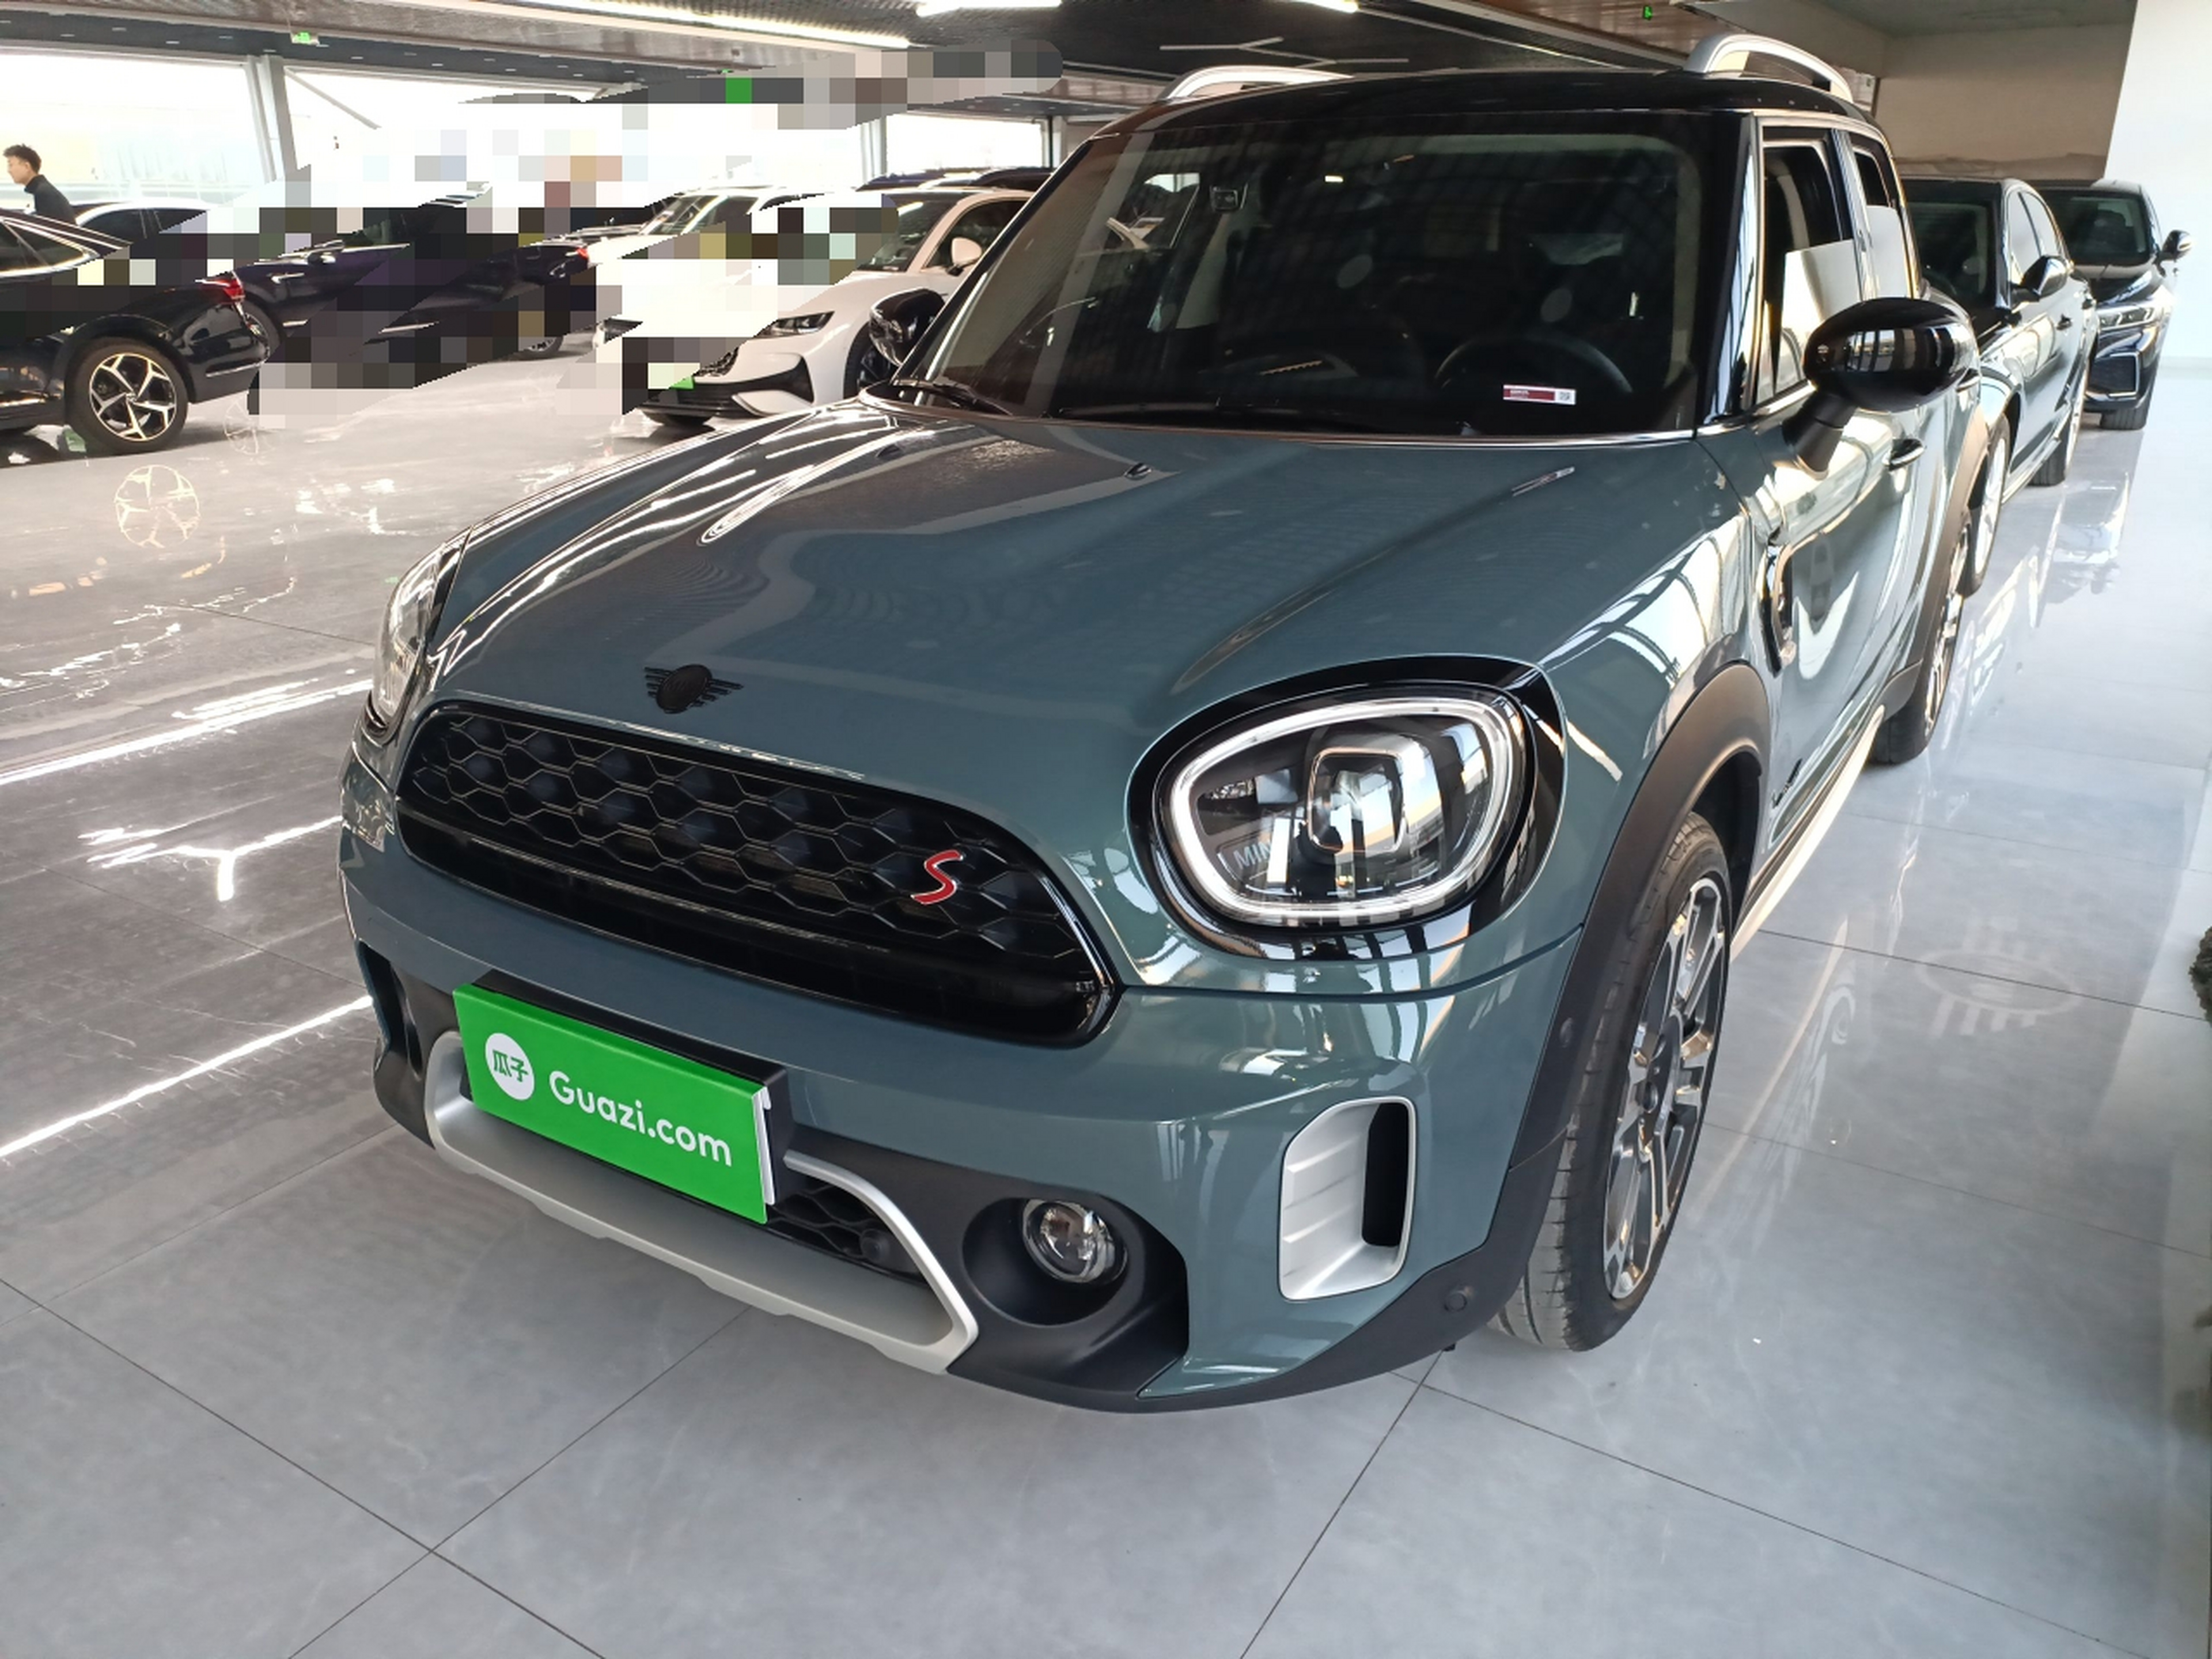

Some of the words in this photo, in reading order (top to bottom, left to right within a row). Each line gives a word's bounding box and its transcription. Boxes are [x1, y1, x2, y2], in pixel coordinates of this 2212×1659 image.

[910, 849, 964, 905] S
[1233, 841, 1271, 869] MIN
[492, 1049, 529, 1082] 瓜子
[549, 1070, 732, 1167] Guazi.com
